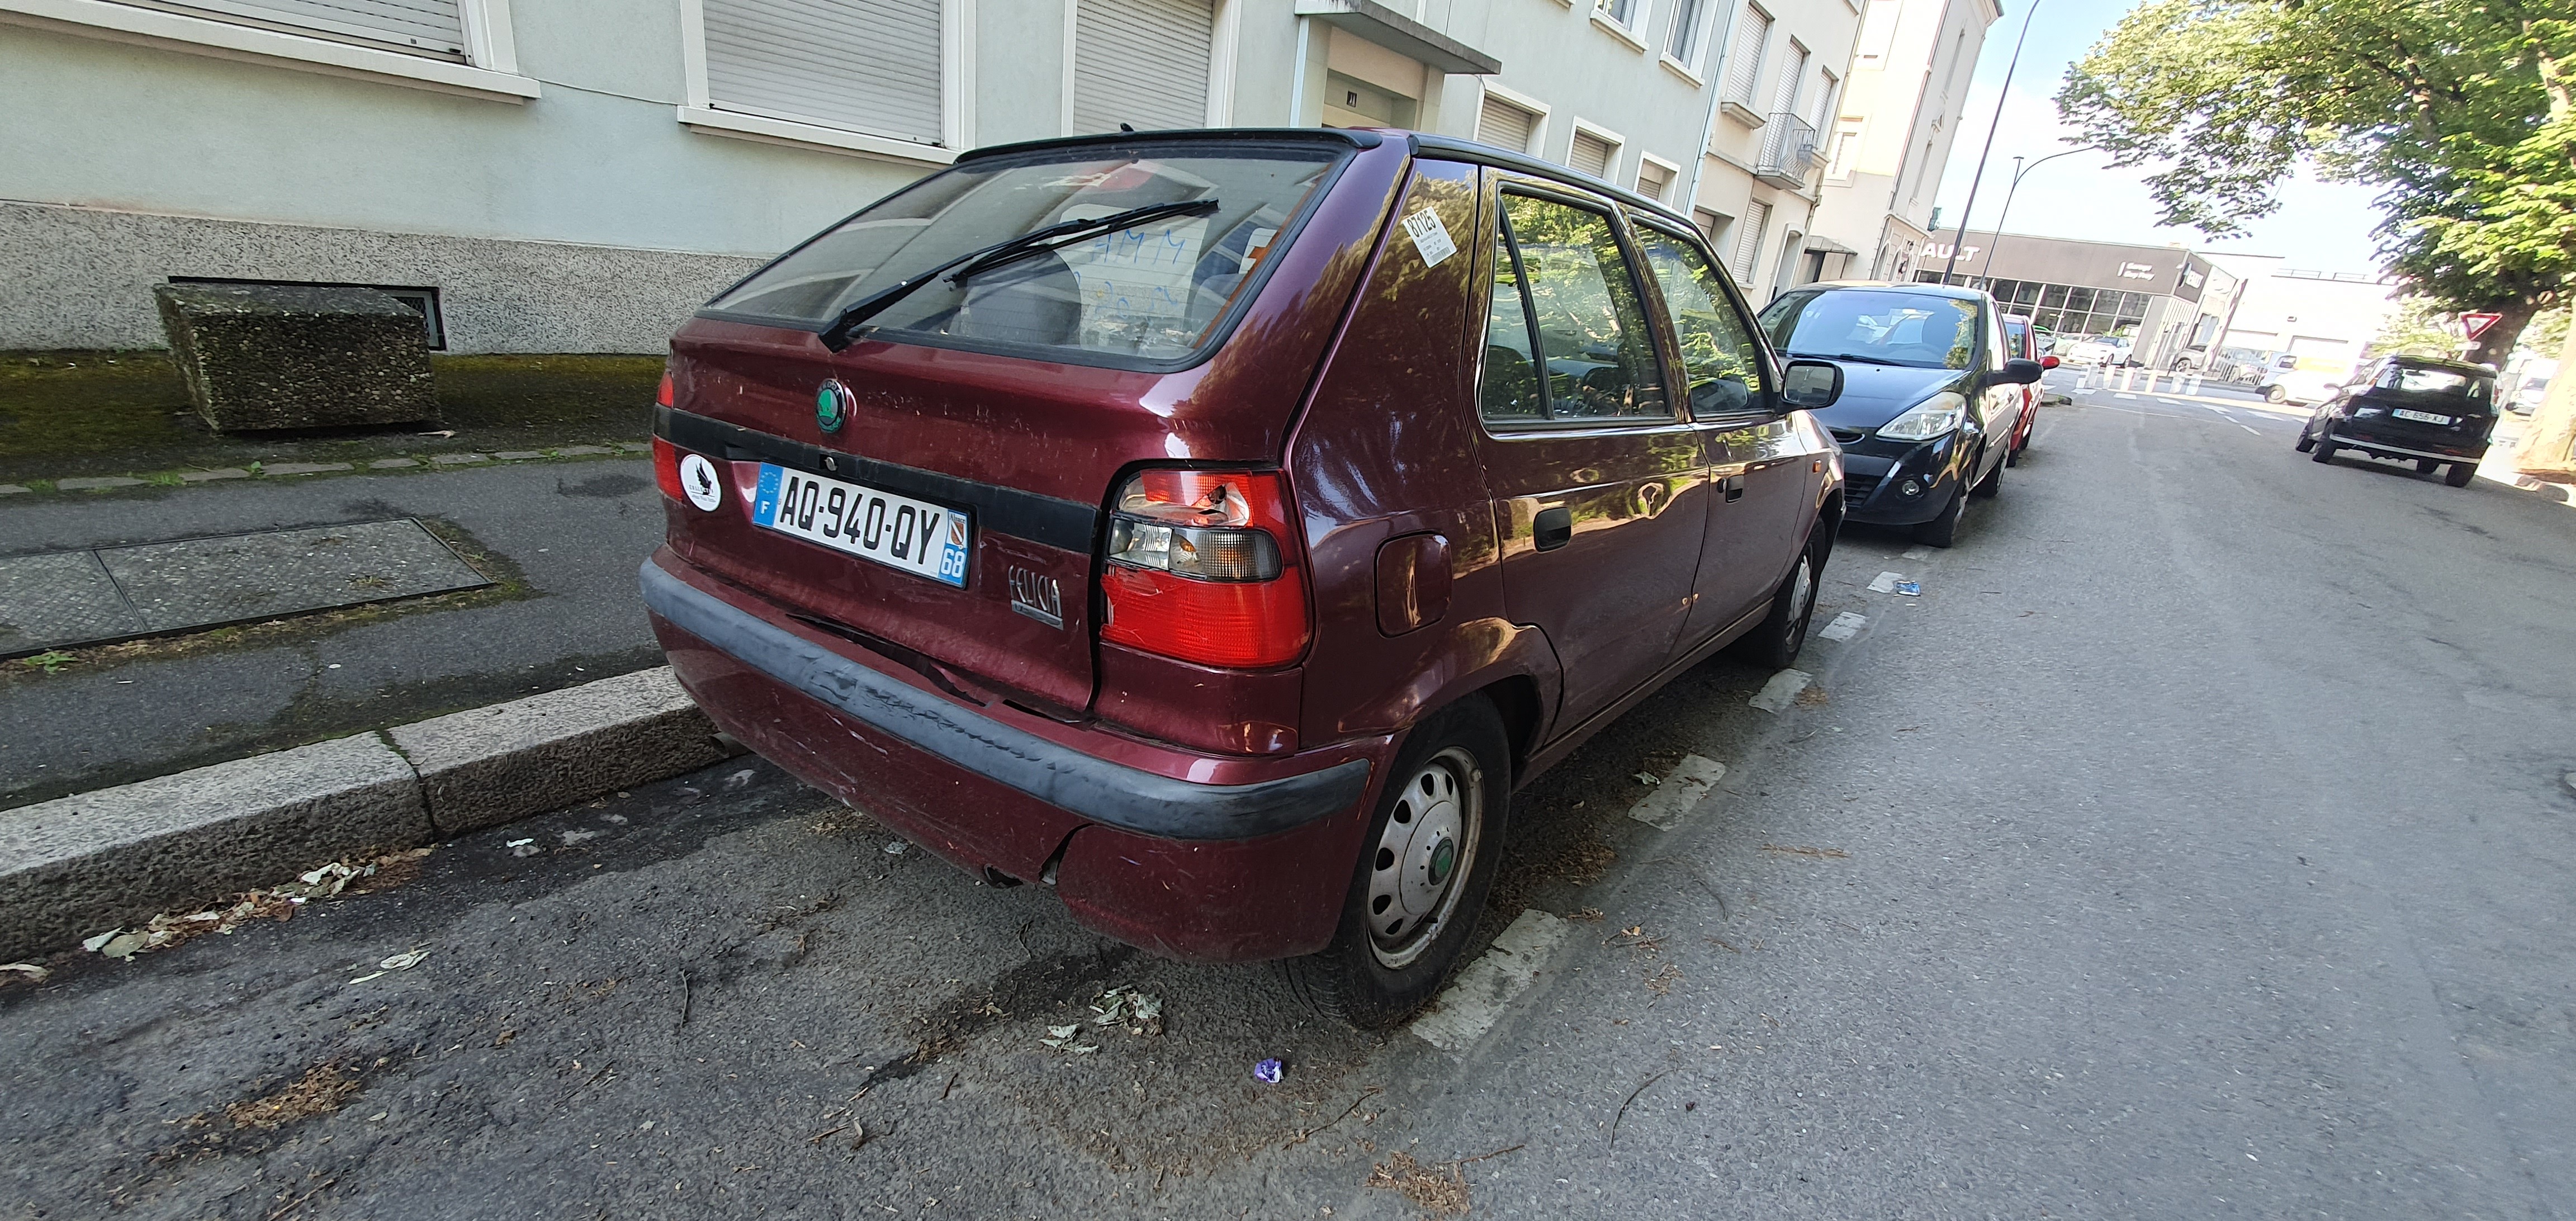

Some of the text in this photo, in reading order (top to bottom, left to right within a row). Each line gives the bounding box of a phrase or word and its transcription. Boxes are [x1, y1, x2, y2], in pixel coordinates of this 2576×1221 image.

[1407, 210, 1436, 238] 87125
[761, 500, 770, 514] F
[780, 476, 940, 565] AQ-940-QY
[940, 548, 965, 578] 68
[1008, 565, 1062, 617] FELICIA
